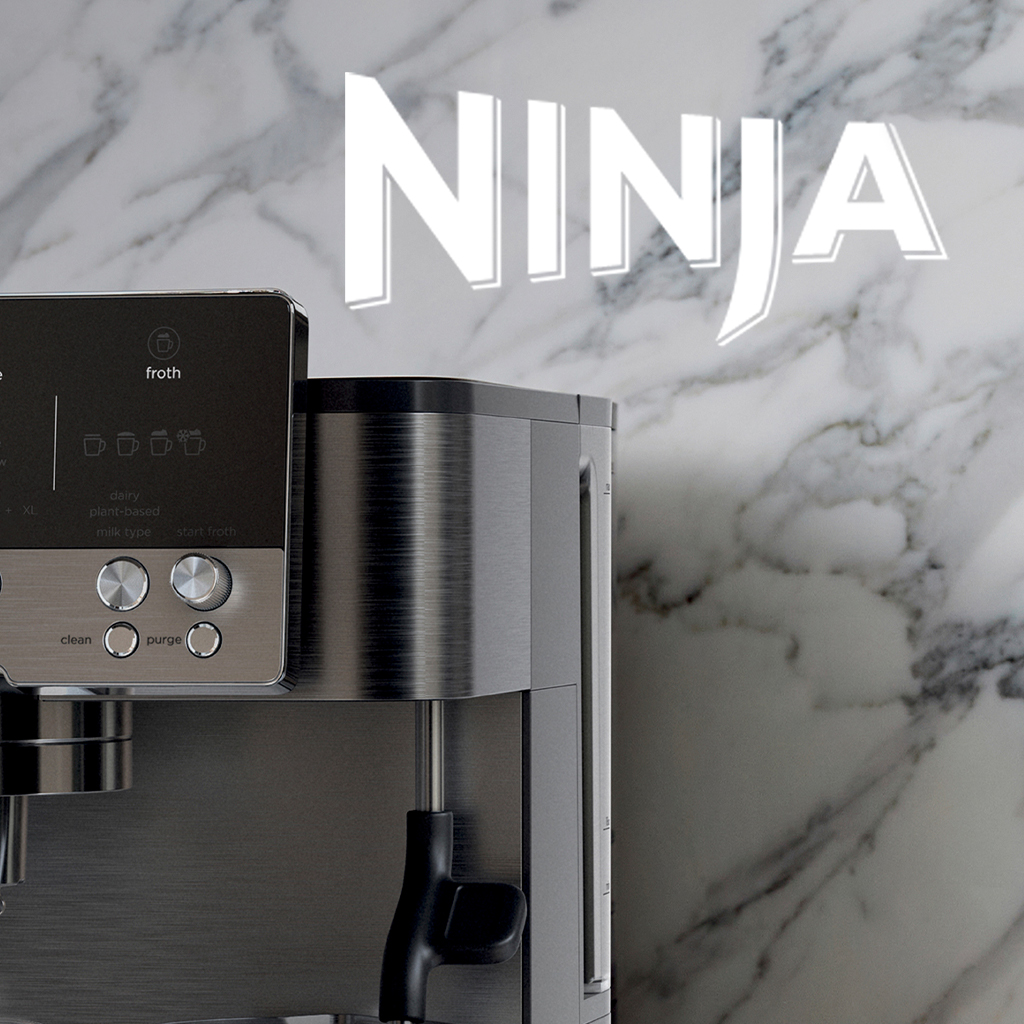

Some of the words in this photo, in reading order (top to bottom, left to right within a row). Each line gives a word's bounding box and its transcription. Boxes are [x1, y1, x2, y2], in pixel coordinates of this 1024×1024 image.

[145, 366, 182, 380] froth
[109, 489, 140, 503] dairy
[22, 504, 38, 516] XL
[88, 505, 161, 519] plant-based
[96, 526, 121, 537] milk
[124, 527, 152, 540] type
[176, 526, 204, 538] start
[207, 525, 237, 537] froth
[59, 634, 93, 645] clean
[146, 635, 183, 647] purge
